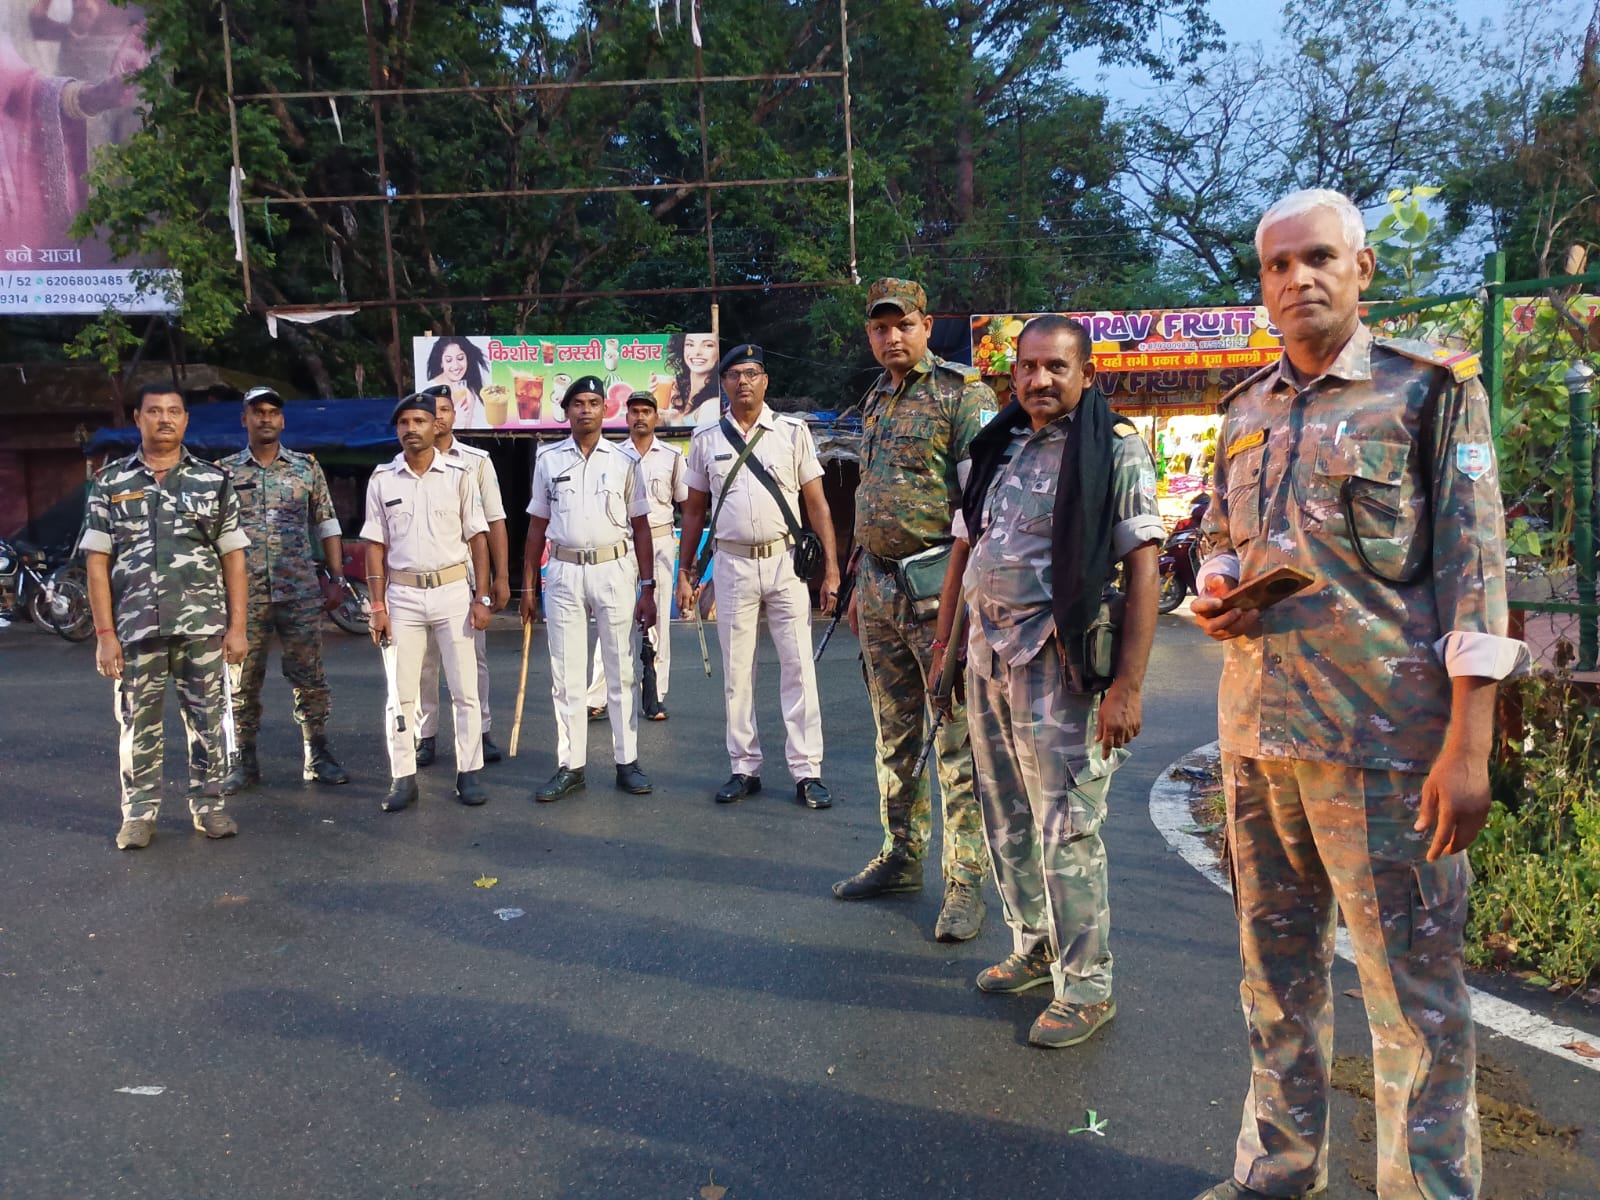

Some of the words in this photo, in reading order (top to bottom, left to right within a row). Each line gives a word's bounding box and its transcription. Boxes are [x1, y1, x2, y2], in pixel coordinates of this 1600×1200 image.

[5, 245, 33, 263] बने
[46, 275, 123, 286] 6206803485
[1163, 312, 1256, 339] FRUIT
[487, 340, 539, 361] किशोर
[557, 339, 602, 361] लस्सी
[621, 339, 663, 361] भंडार
[1129, 369, 1210, 395] FRUIT
